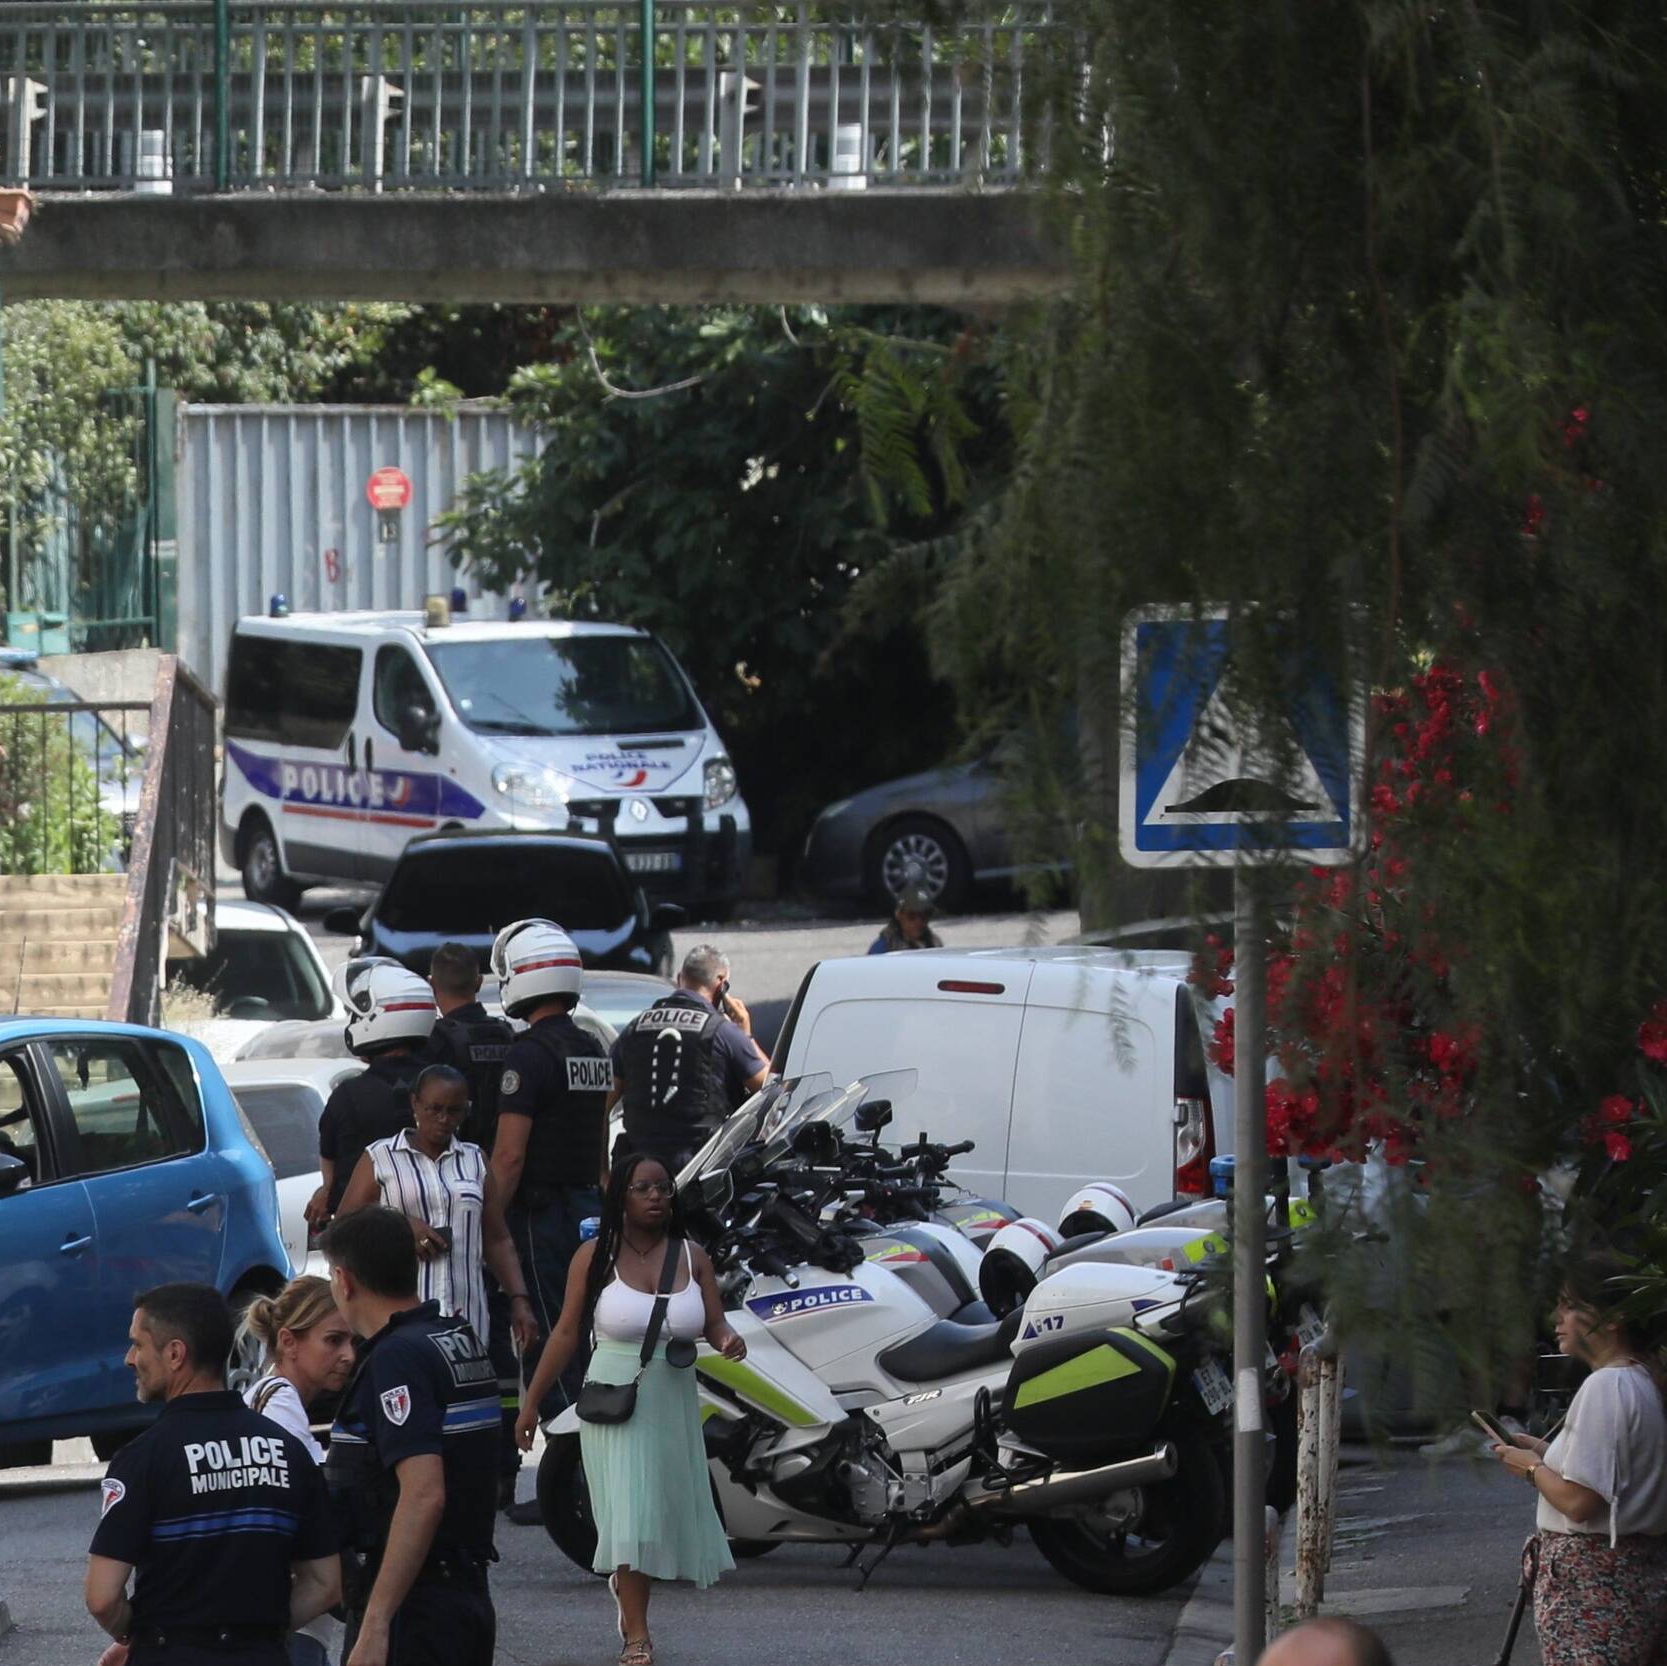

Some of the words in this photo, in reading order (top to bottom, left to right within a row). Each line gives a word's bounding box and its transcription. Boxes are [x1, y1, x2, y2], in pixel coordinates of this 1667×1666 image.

[283, 763, 384, 807] POLICE
[640, 1010, 704, 1025] POLICE
[569, 1061, 612, 1086] POLICE
[791, 1286, 863, 1311] POLICE
[1042, 1315, 1065, 1331] 17
[184, 1436, 288, 1473] POLICE
[190, 1467, 290, 1494] MUNICIPALE
